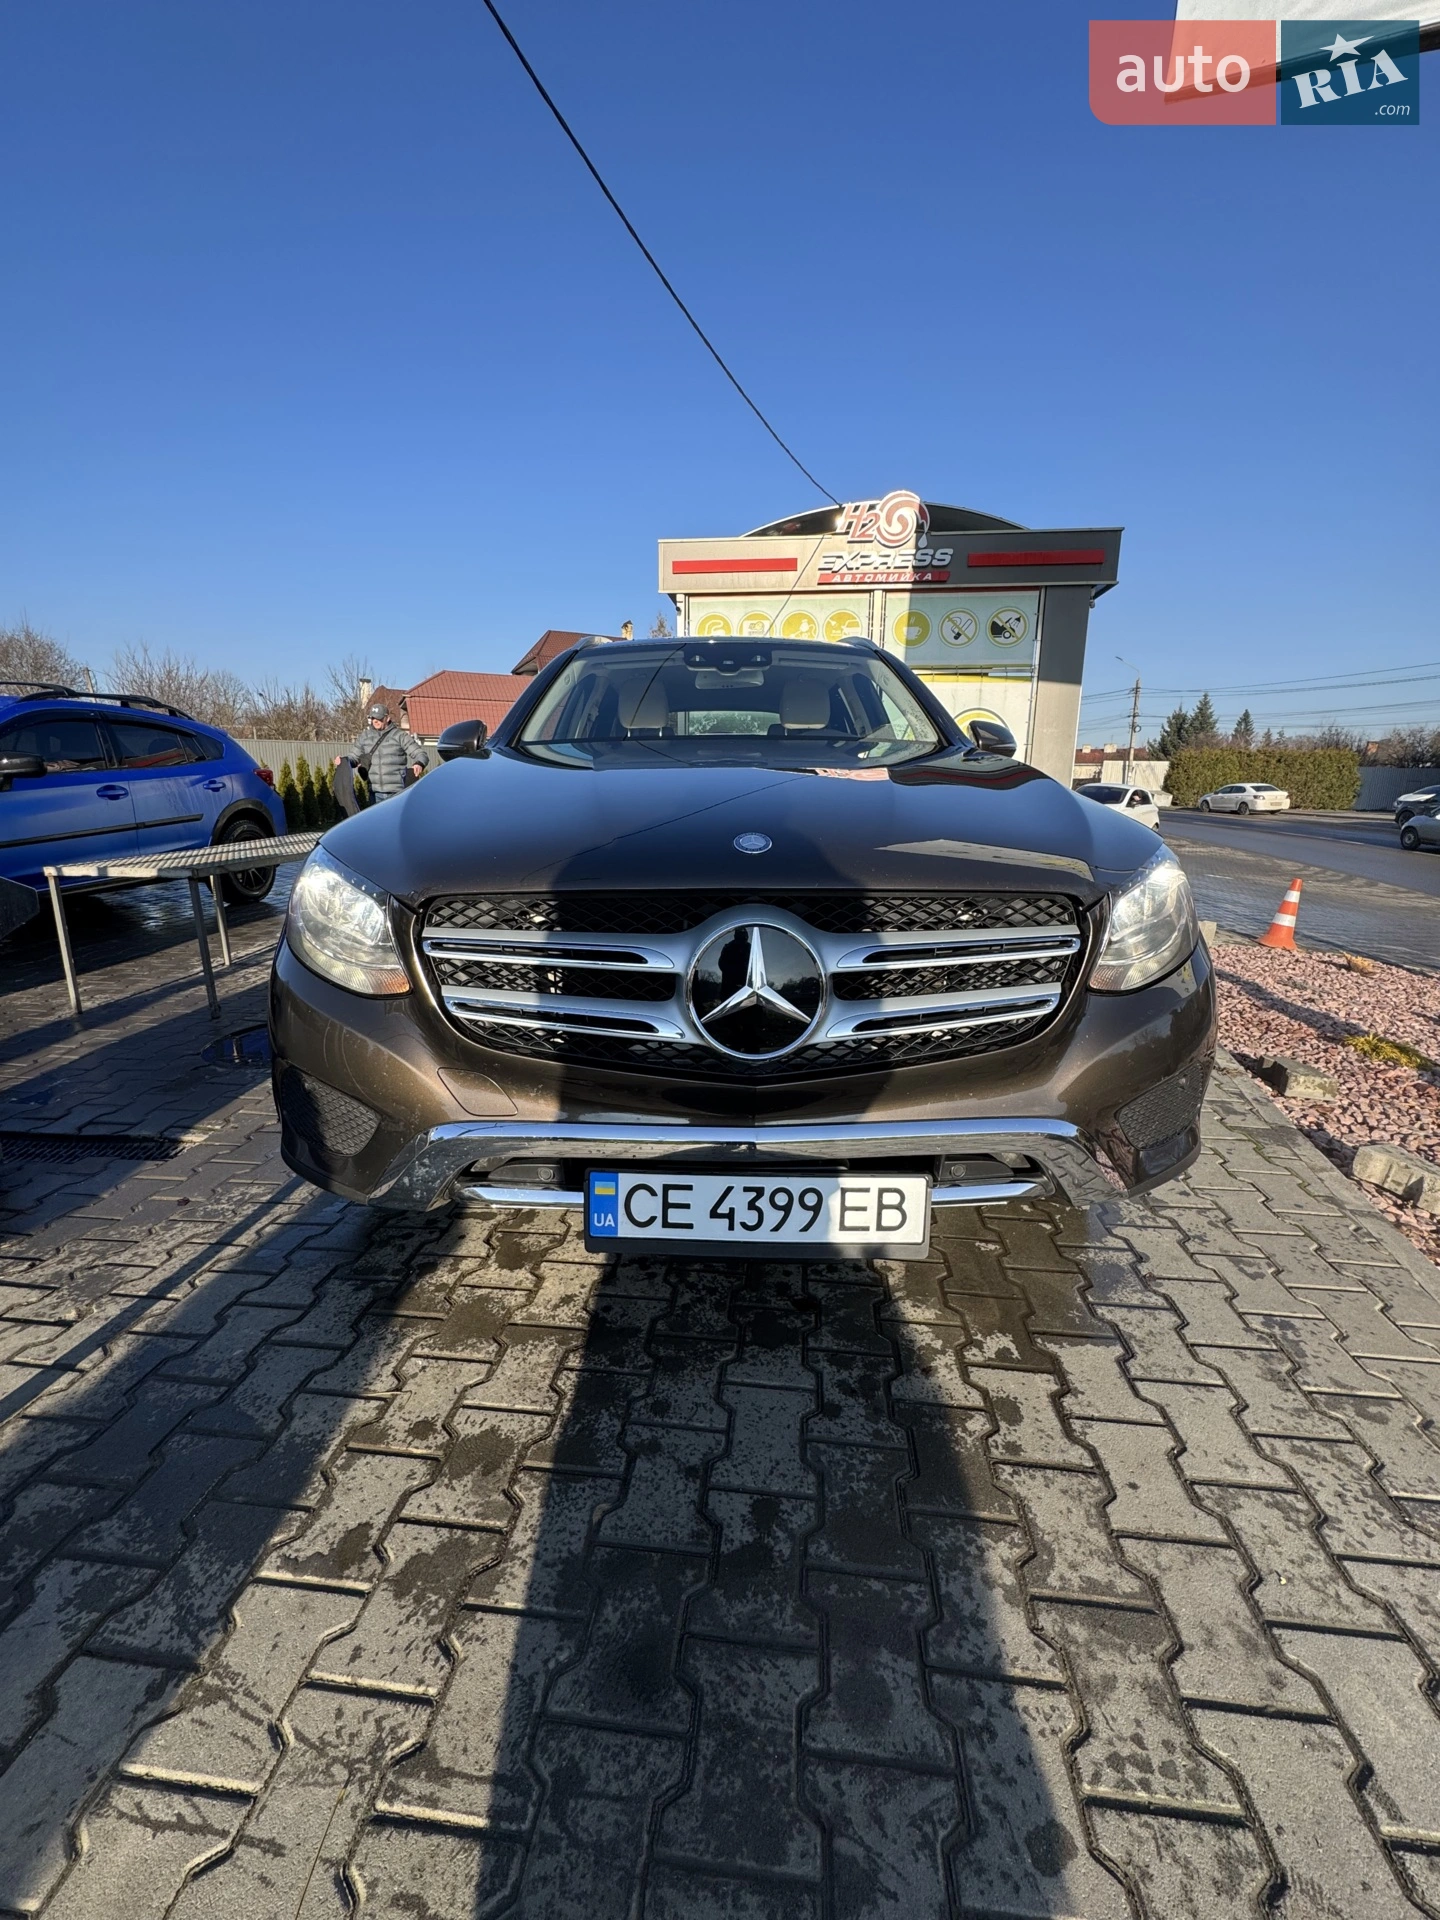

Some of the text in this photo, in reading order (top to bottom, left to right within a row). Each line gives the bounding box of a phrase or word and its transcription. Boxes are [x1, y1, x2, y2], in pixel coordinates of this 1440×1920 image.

[818, 548, 953, 572] EXPRESS
[623, 1182, 908, 1232] CE 4399 EB
[594, 1212, 615, 1228] UA
